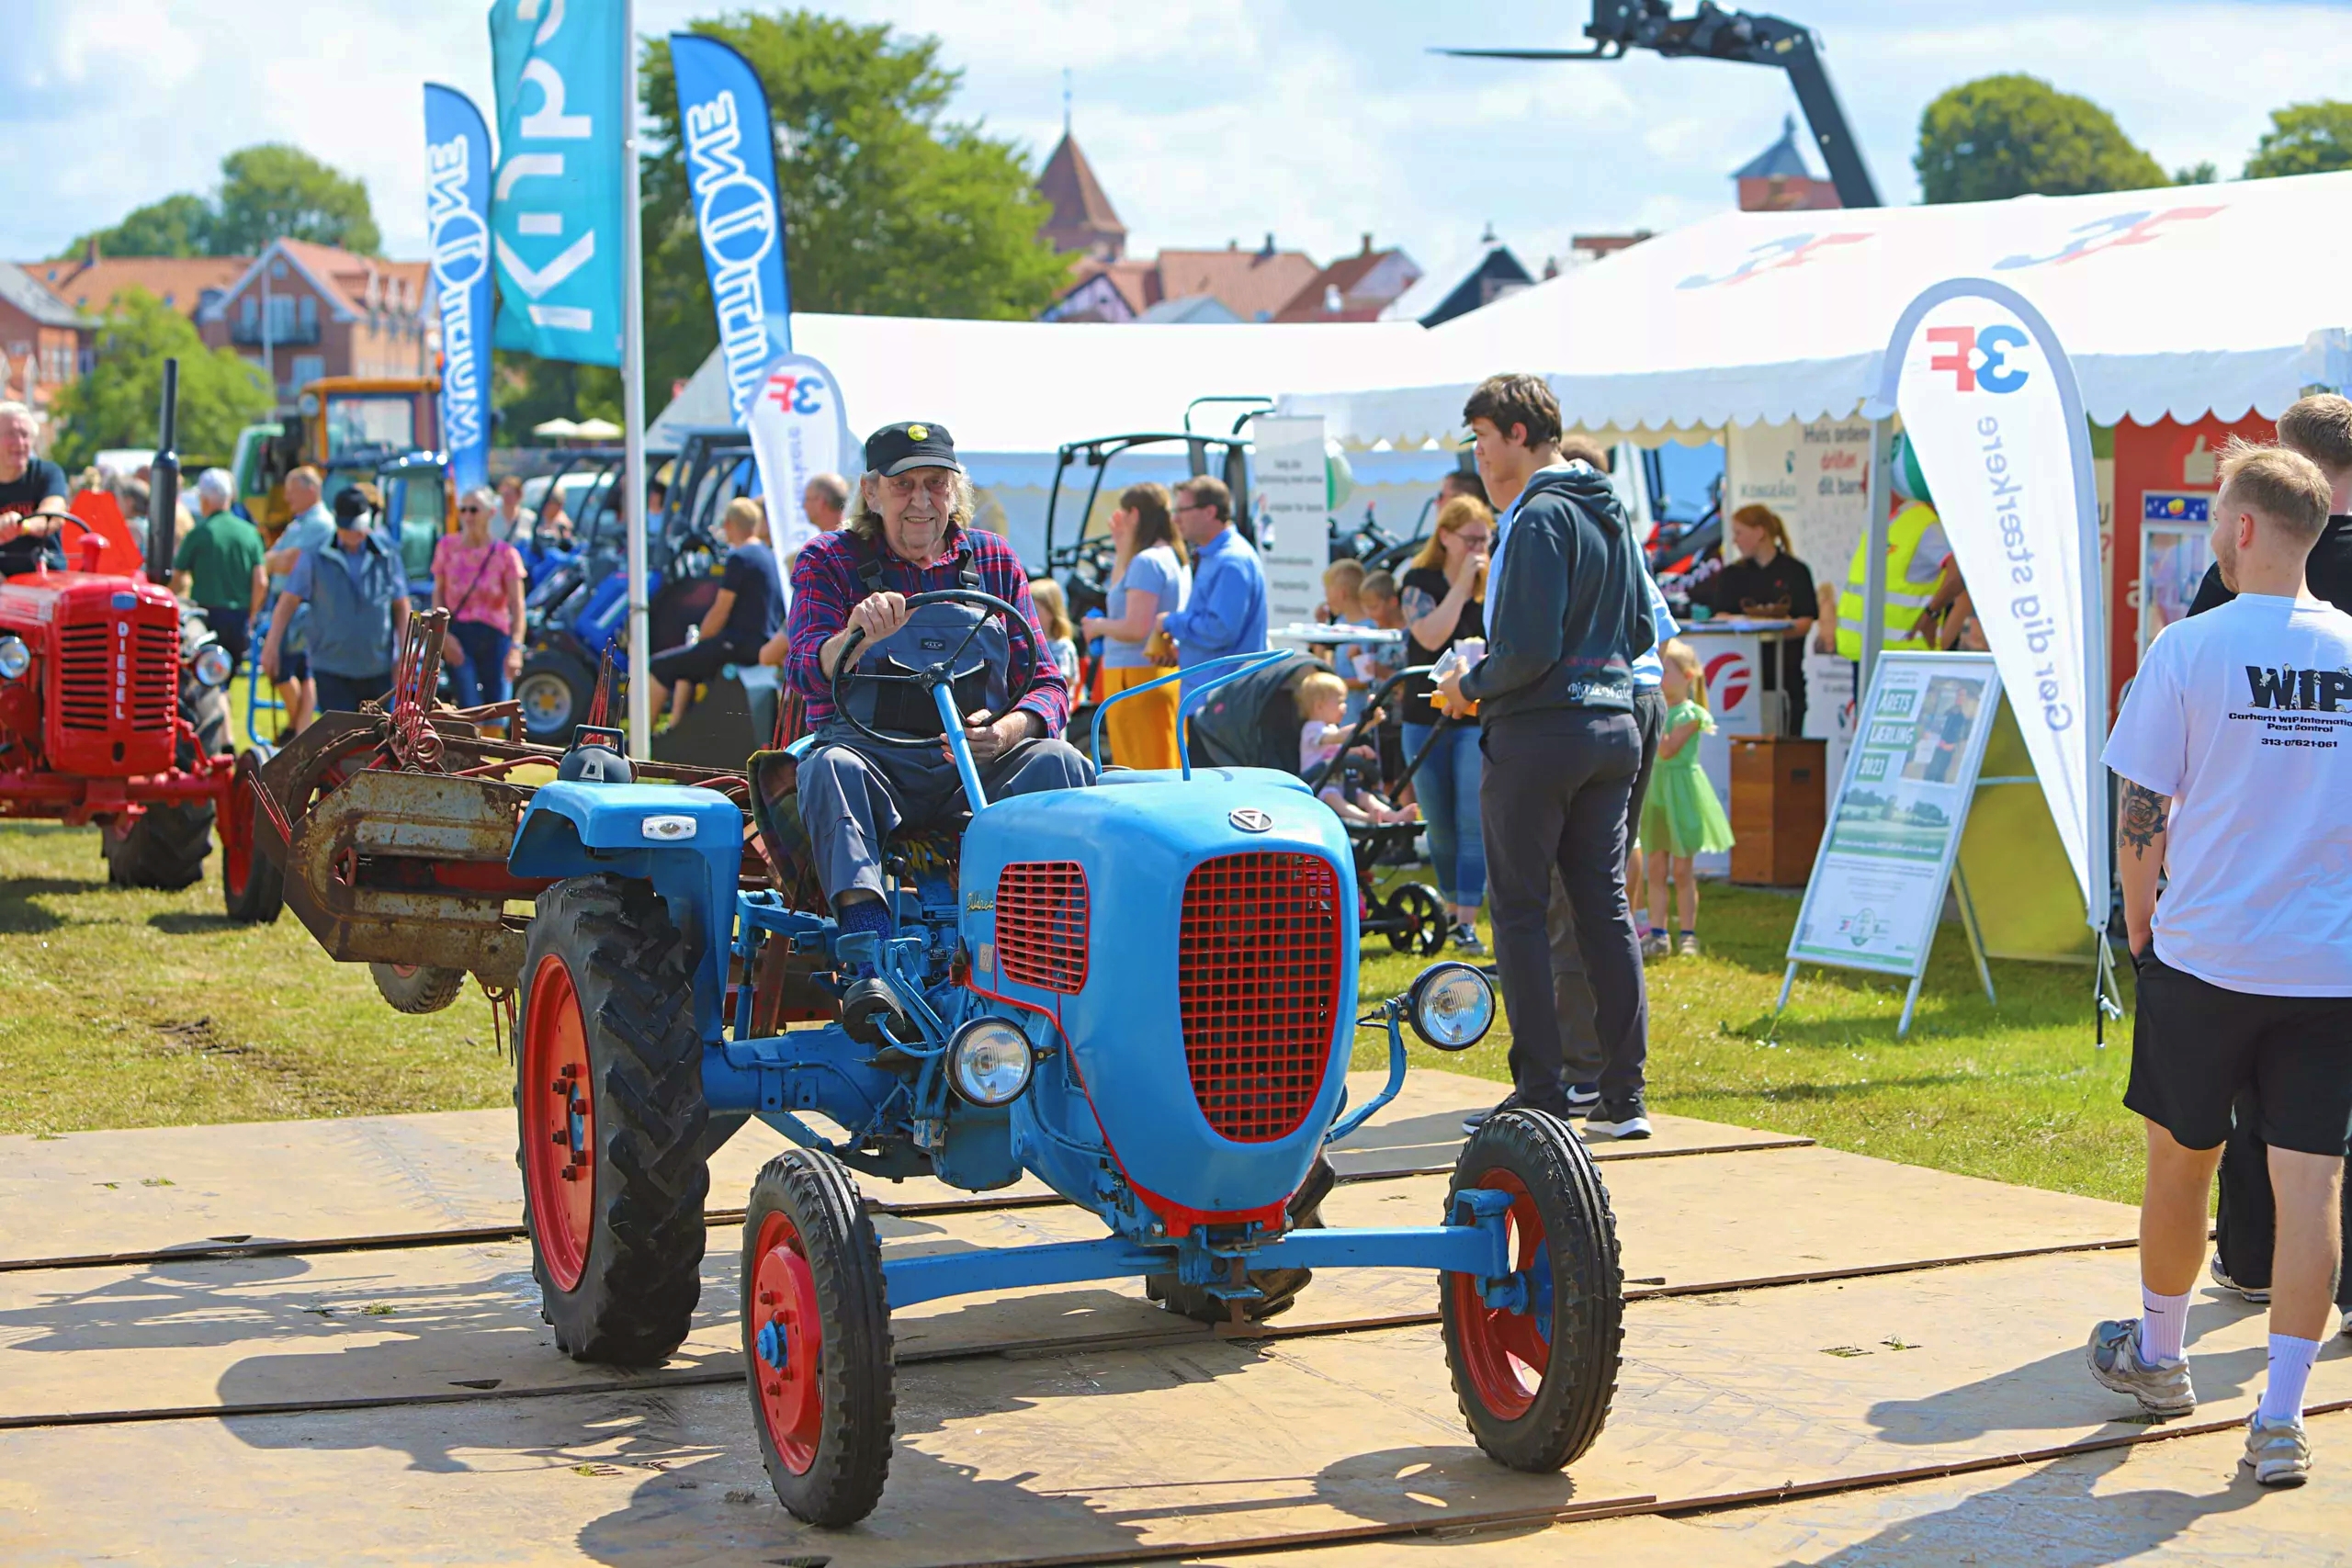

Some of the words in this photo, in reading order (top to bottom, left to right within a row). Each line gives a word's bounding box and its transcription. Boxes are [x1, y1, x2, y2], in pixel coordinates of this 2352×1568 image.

[116, 621, 130, 720] DIESEL
[2228, 712, 2276, 723] Carhartt
[2267, 722, 2293, 731] Pest
[2295, 723, 2334, 733] Control
